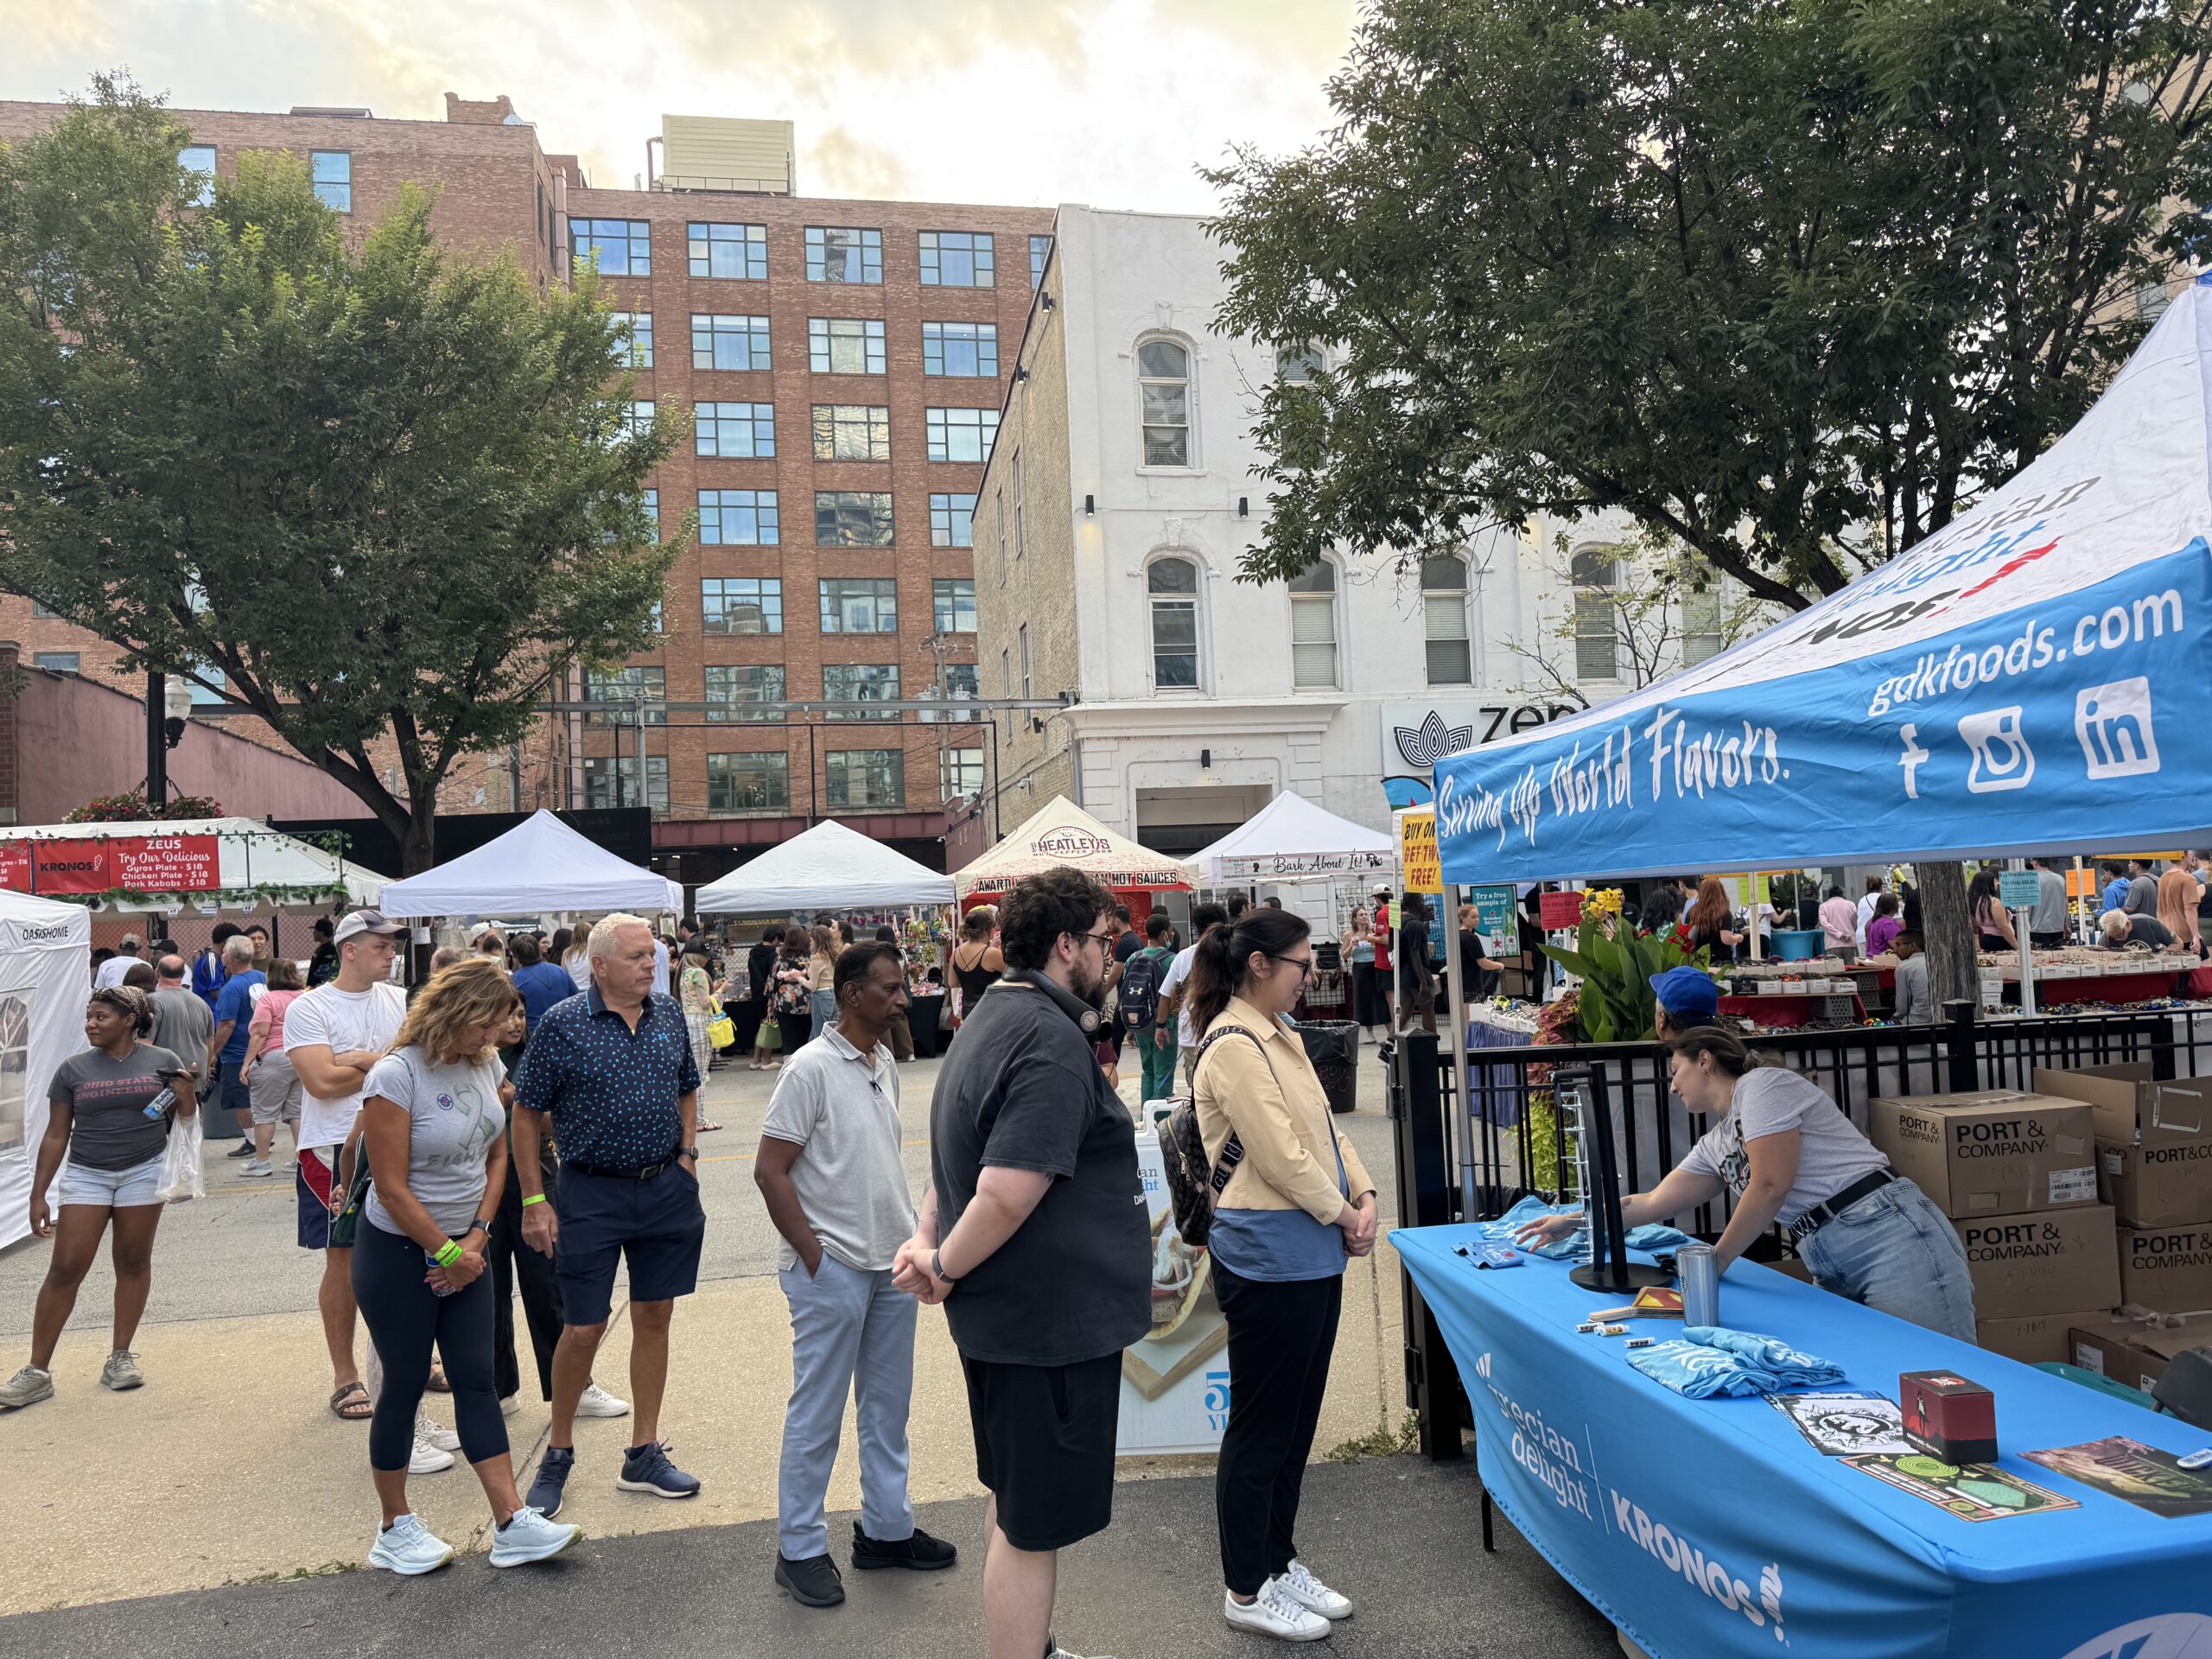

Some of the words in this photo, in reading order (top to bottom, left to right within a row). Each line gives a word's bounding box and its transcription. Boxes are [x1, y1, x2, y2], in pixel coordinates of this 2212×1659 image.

[1867, 588, 2183, 717] gdkfoods.com
[1440, 774, 1508, 853] Serving
[1510, 764, 1541, 849] Up
[1551, 725, 1634, 817] World
[1644, 707, 1789, 803] Flavors.
[1404, 823, 1422, 841] BUY
[1423, 821, 1436, 839] ON
[146, 839, 181, 850] ZEUS
[1038, 837, 1111, 852] HEATLEY'S
[1404, 845, 1421, 863] GET
[40, 861, 92, 872] KRONOS
[118, 852, 137, 865] Try
[139, 852, 160, 864] Our
[162, 850, 211, 862] Delicious
[1274, 856, 1305, 874] Bark
[1308, 855, 1344, 871] About
[1347, 852, 1363, 870] It!
[978, 879, 1012, 893] AWARD
[1111, 873, 1133, 886] HOT
[1136, 872, 1178, 886] SAUCES
[1410, 868, 1436, 887] FREE!
[22, 925, 69, 941] OASISHOME
[75, 1084, 163, 1100] ENGINEERING
[83, 1079, 114, 1089] OHIO
[116, 1076, 156, 1085] STATE
[1899, 1114, 1929, 1133] PORT
[1930, 1122, 1939, 1135] &
[1956, 1121, 2022, 1143] PORT
[2027, 1119, 2046, 1138] &
[1899, 1126, 1941, 1144] COMPANY
[427, 1147, 486, 1166] FIGH
[1957, 1139, 2048, 1159] COMPANY
[1966, 1223, 2037, 1246] PORT
[2042, 1222, 2062, 1241] &
[2133, 1233, 2196, 1254] PORT
[2199, 1232, 2212, 1250] &
[1967, 1241, 2063, 1262] COMPANY
[2133, 1252, 2212, 1270] COMPANY
[1205, 1371, 1230, 1411] 5
[1511, 1427, 1593, 1522] delight
[1611, 1488, 1764, 1627] KRONOS
